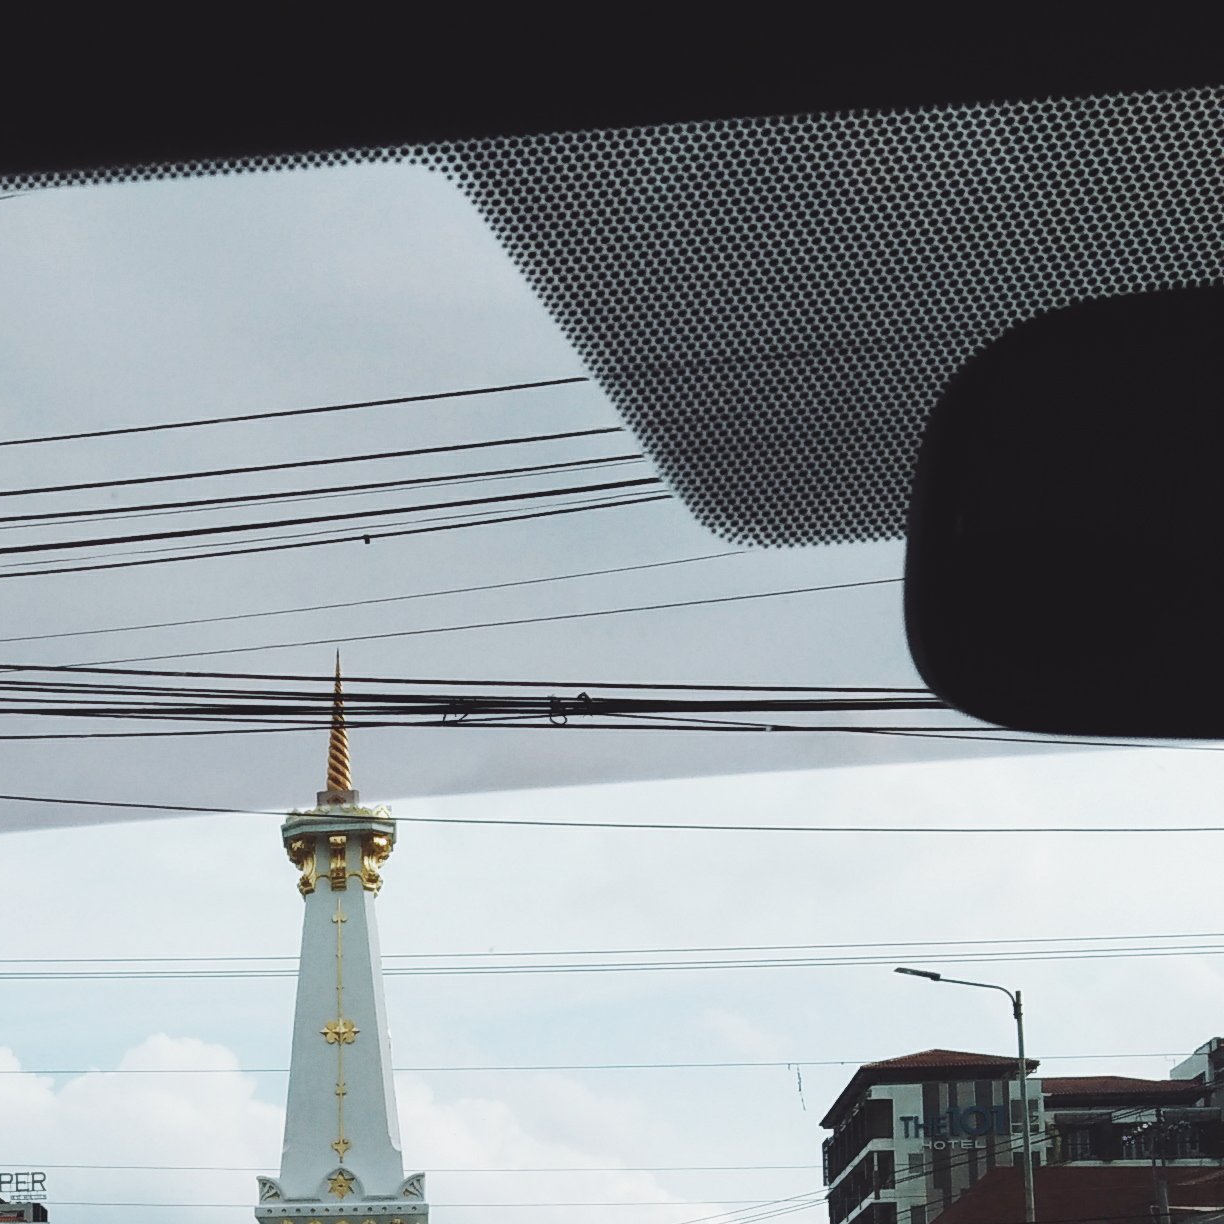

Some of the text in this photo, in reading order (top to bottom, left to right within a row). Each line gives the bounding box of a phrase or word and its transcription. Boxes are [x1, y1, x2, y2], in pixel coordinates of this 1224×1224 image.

[899, 1105, 1010, 1138] THE 101
[922, 1140, 987, 1151] HOTEL
